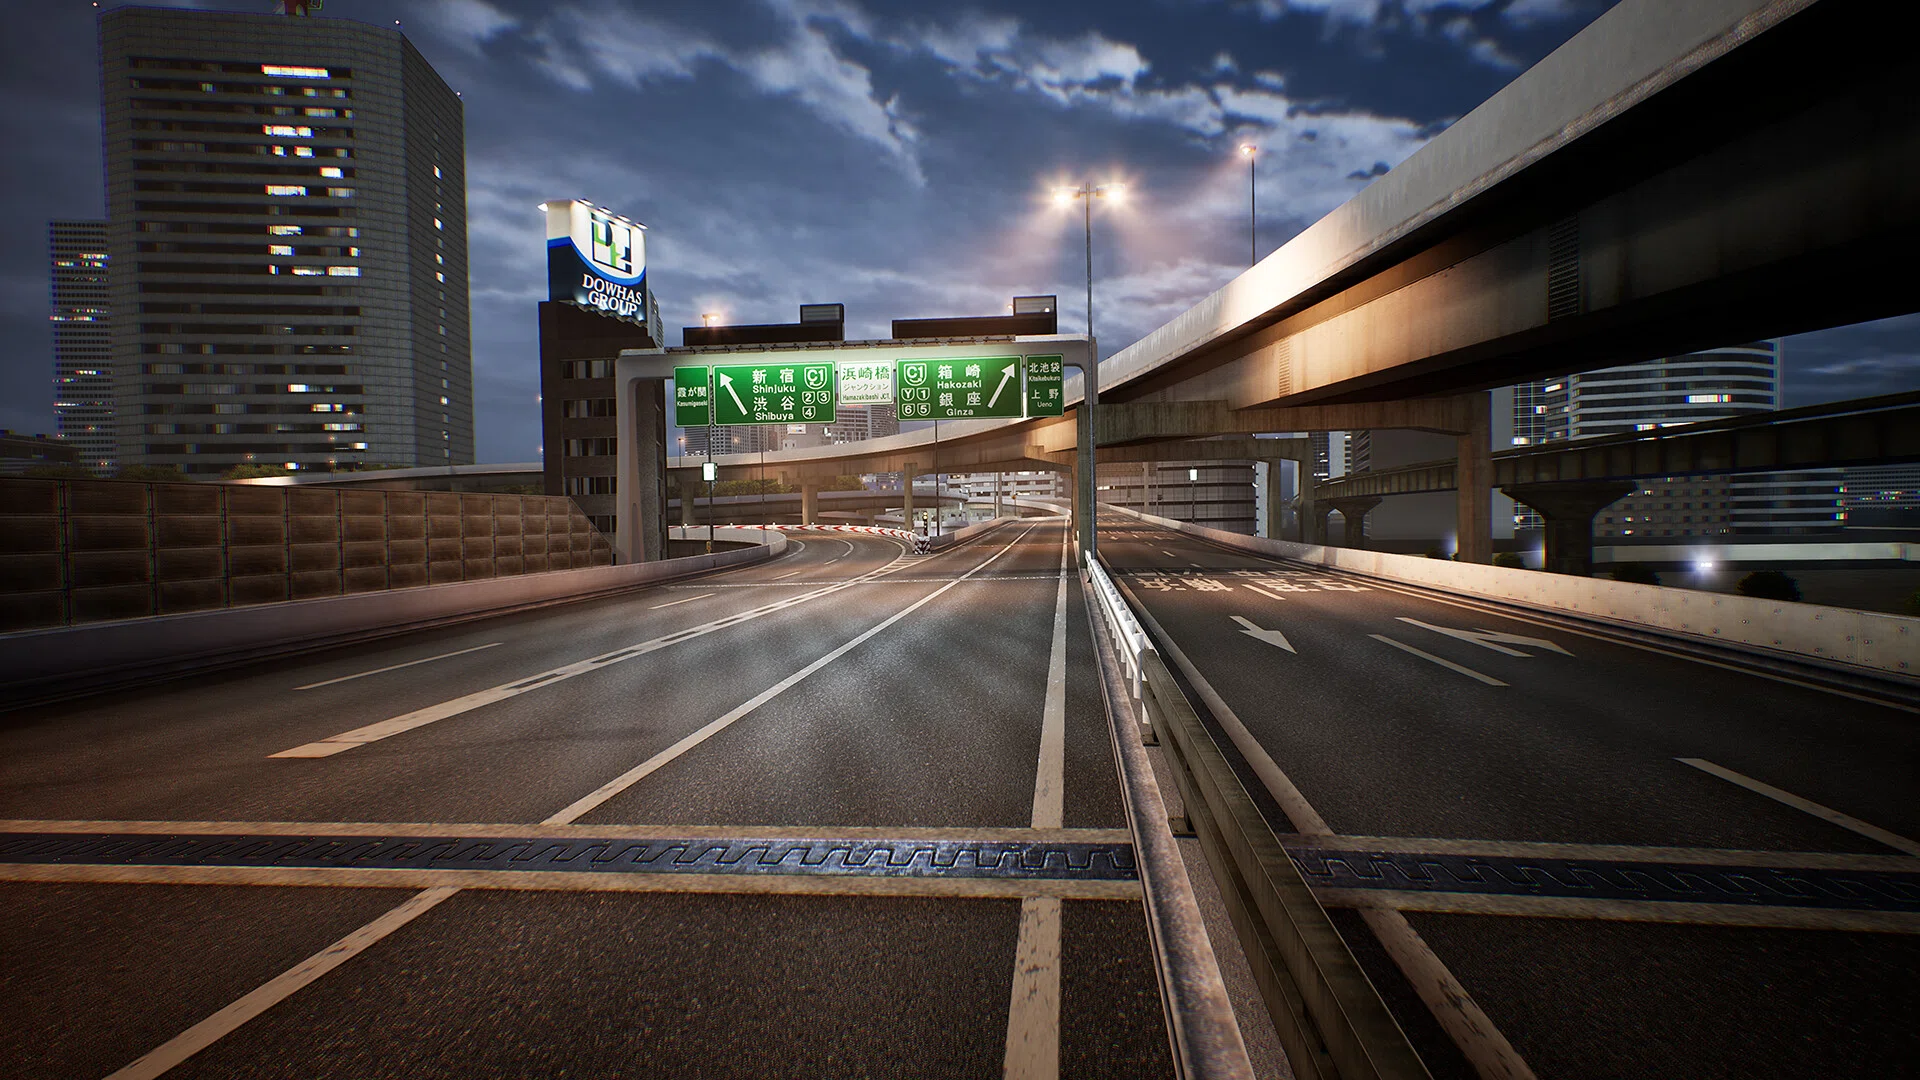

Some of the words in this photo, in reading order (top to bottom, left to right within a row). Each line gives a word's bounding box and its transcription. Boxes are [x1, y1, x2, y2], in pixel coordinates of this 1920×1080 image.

[582, 273, 642, 305] DOWHAS
[588, 290, 638, 316] GROUP
[842, 366, 890, 381] 浜崎橋
[906, 366, 924, 379] C1
[938, 364, 981, 379] 箱崎
[1029, 362, 1061, 373] 北池袋
[752, 368, 795, 385] 新宿
[807, 369, 824, 382] C1
[752, 384, 796, 394] Shinjuku
[843, 383, 889, 392] ジャンクション
[937, 380, 982, 389] Hakozaki
[677, 386, 707, 398] 霞が関
[804, 392, 812, 402] 2
[820, 392, 828, 402] 3
[904, 389, 912, 399] Y
[920, 389, 926, 399] 1
[1031, 388, 1060, 400] 上野
[753, 395, 795, 412] 渋谷
[939, 391, 981, 407] 銀座
[804, 408, 813, 417] 4
[904, 405, 912, 414] 6
[920, 405, 927, 414] 5
[946, 408, 974, 417] Ginza
[755, 412, 794, 422] Shibuya
